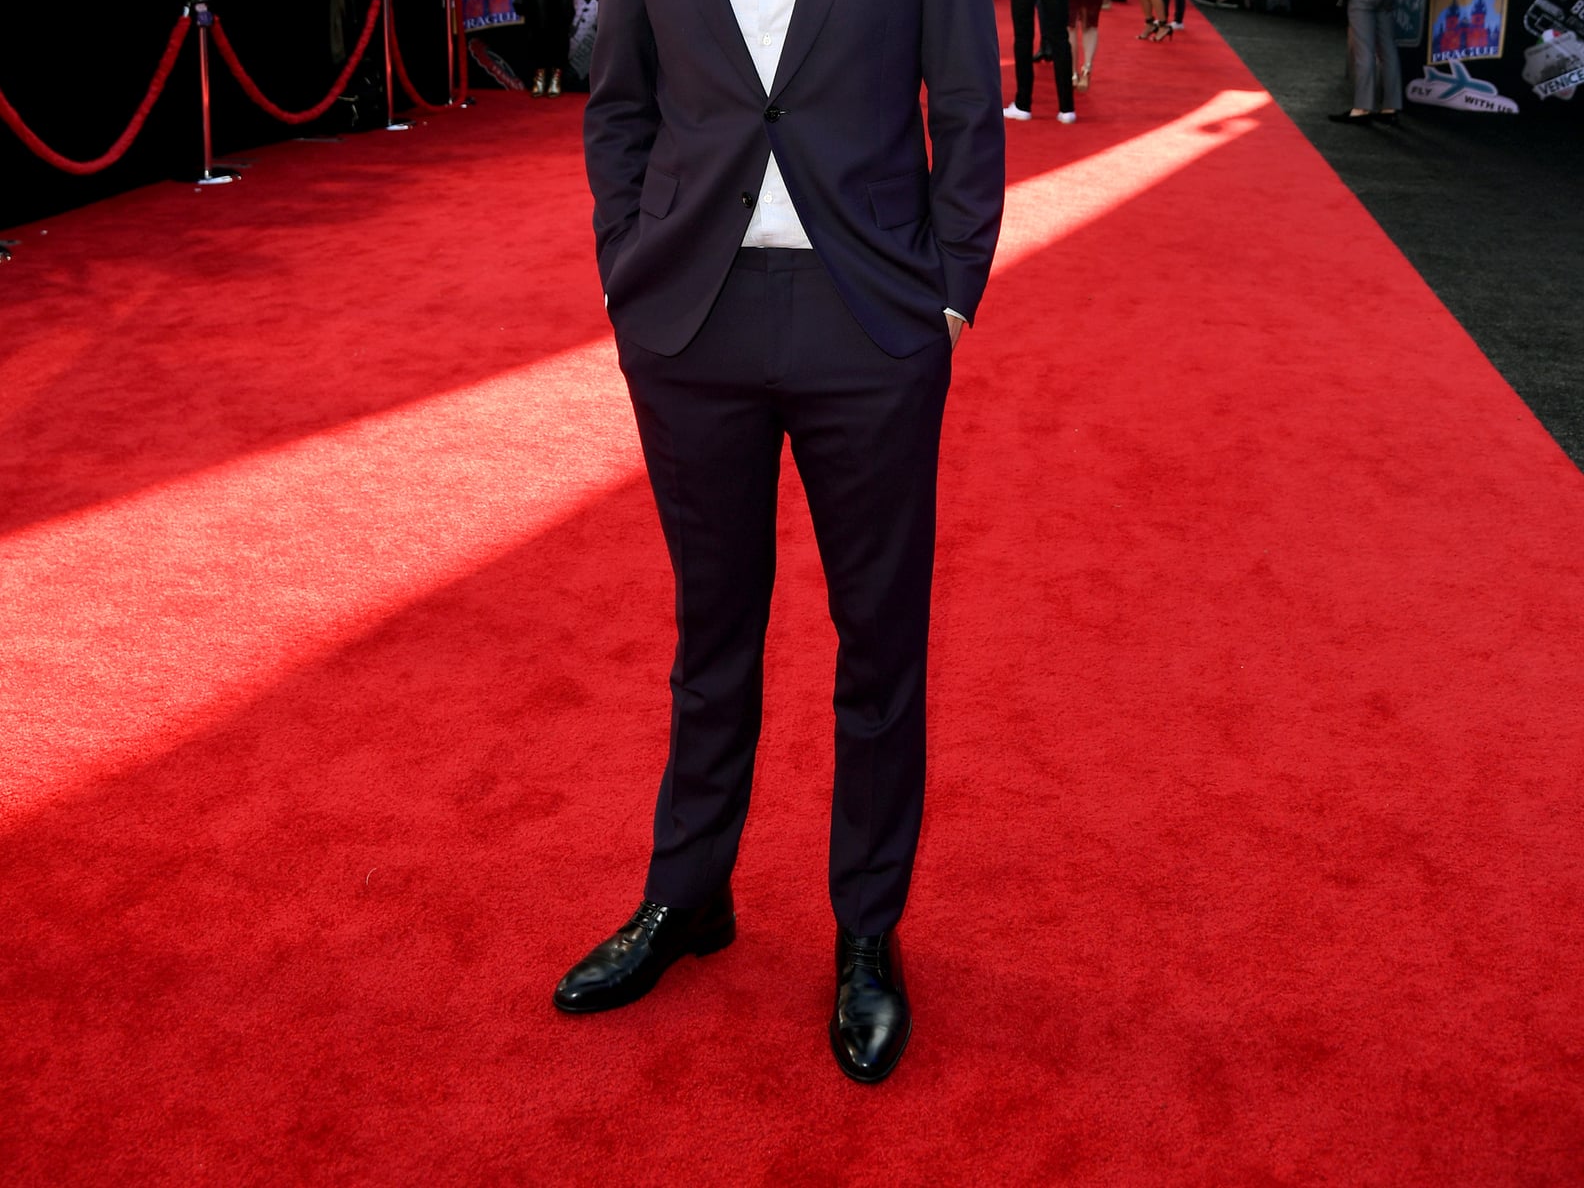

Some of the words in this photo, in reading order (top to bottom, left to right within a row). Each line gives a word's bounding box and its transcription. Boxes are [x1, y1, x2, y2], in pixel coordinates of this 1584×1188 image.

[464, 11, 520, 29] RAGUE
[1432, 45, 1498, 62] PRAGUE
[1410, 85, 1432, 96] FLY
[1538, 69, 1584, 96] VENICE
[1464, 95, 1495, 110] WITH
